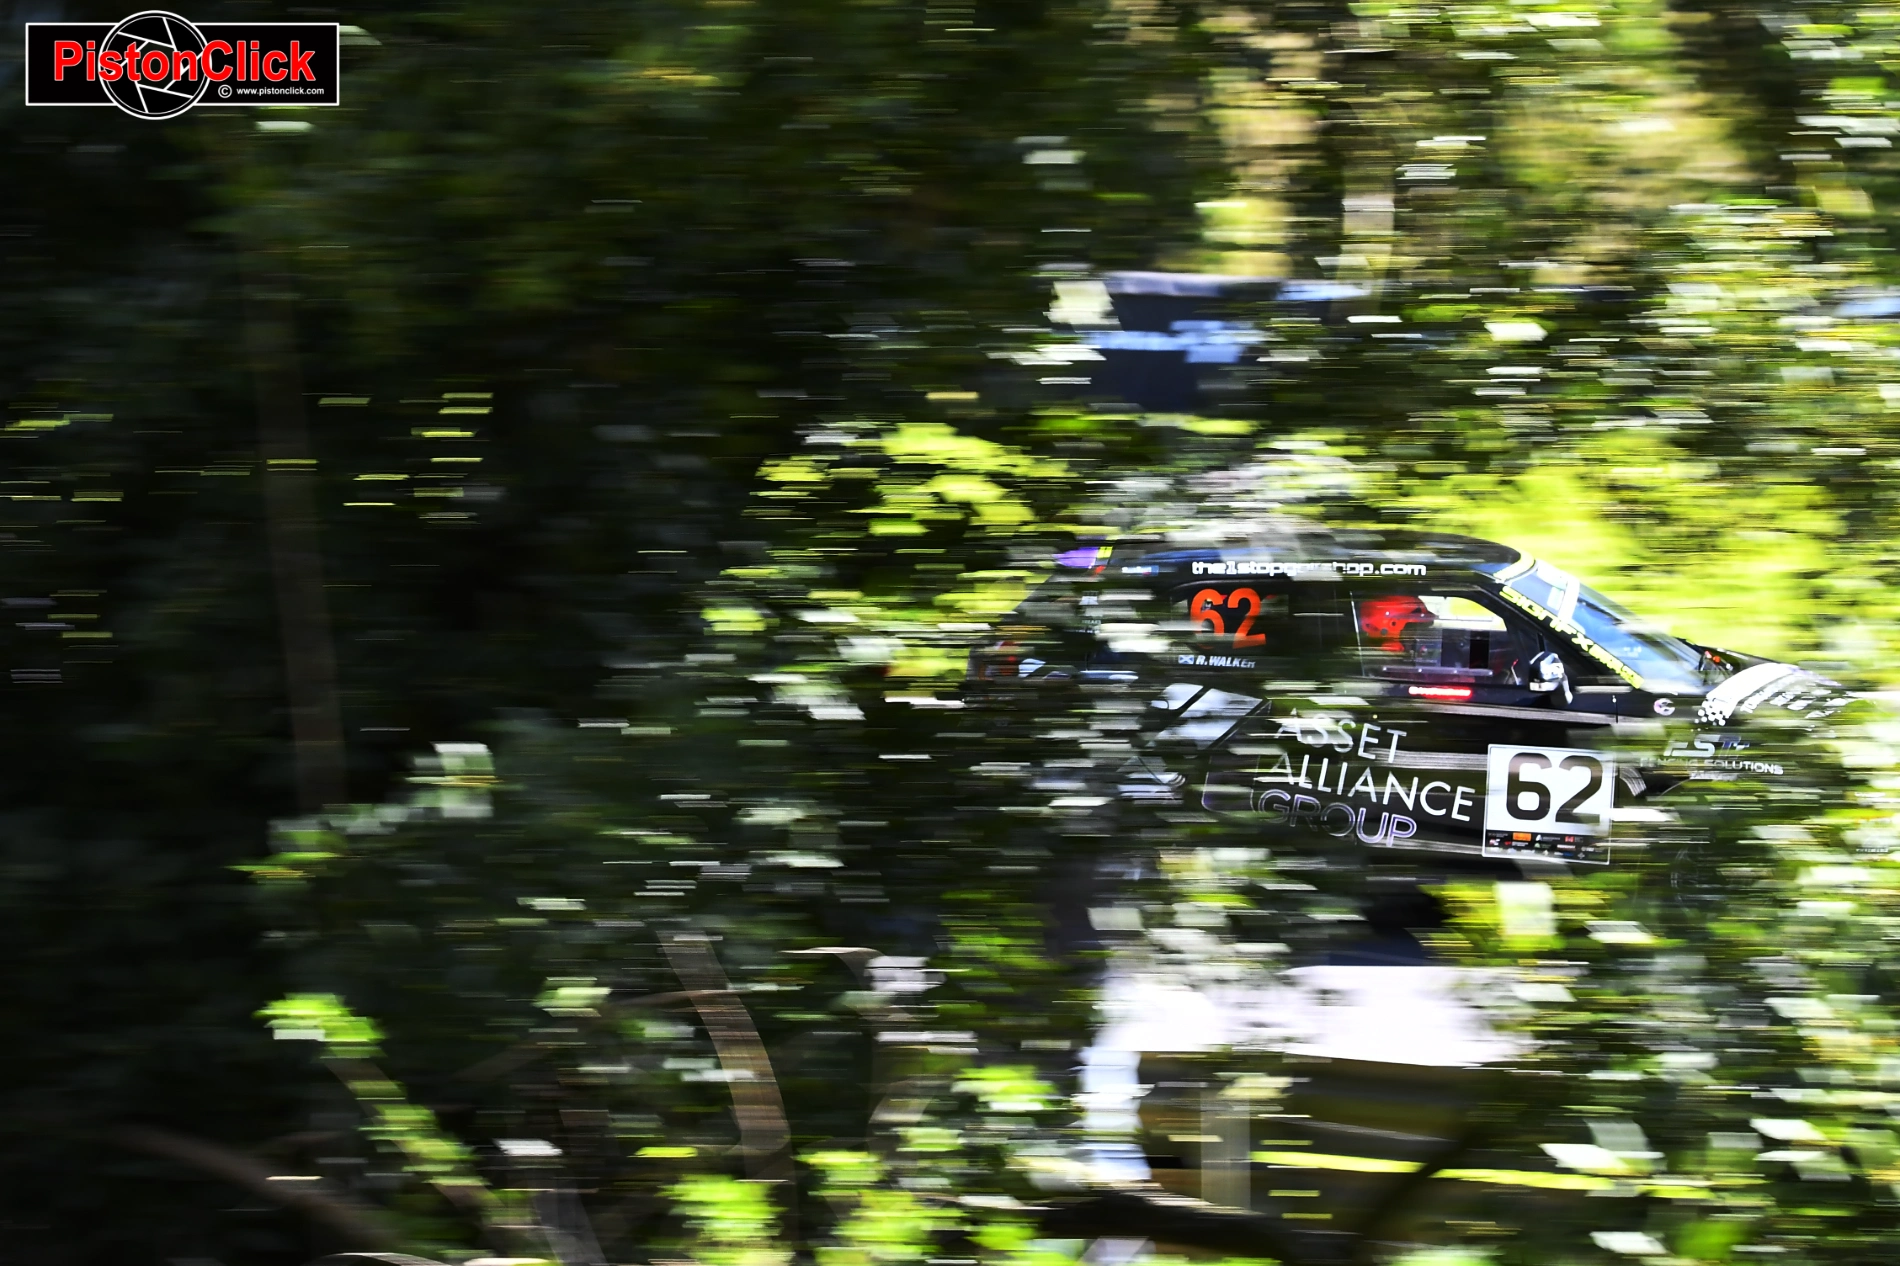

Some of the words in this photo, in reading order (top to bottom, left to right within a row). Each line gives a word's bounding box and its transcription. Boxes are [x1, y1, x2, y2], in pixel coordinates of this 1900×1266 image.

[1190, 587, 1266, 649] 62
[1274, 708, 1407, 763] ASSET
[1269, 752, 1475, 822] ALLIANCE
[1505, 752, 1603, 823] 62
[1704, 759, 1784, 775] SOLUTIONS
[1257, 789, 1418, 848] GROUP
